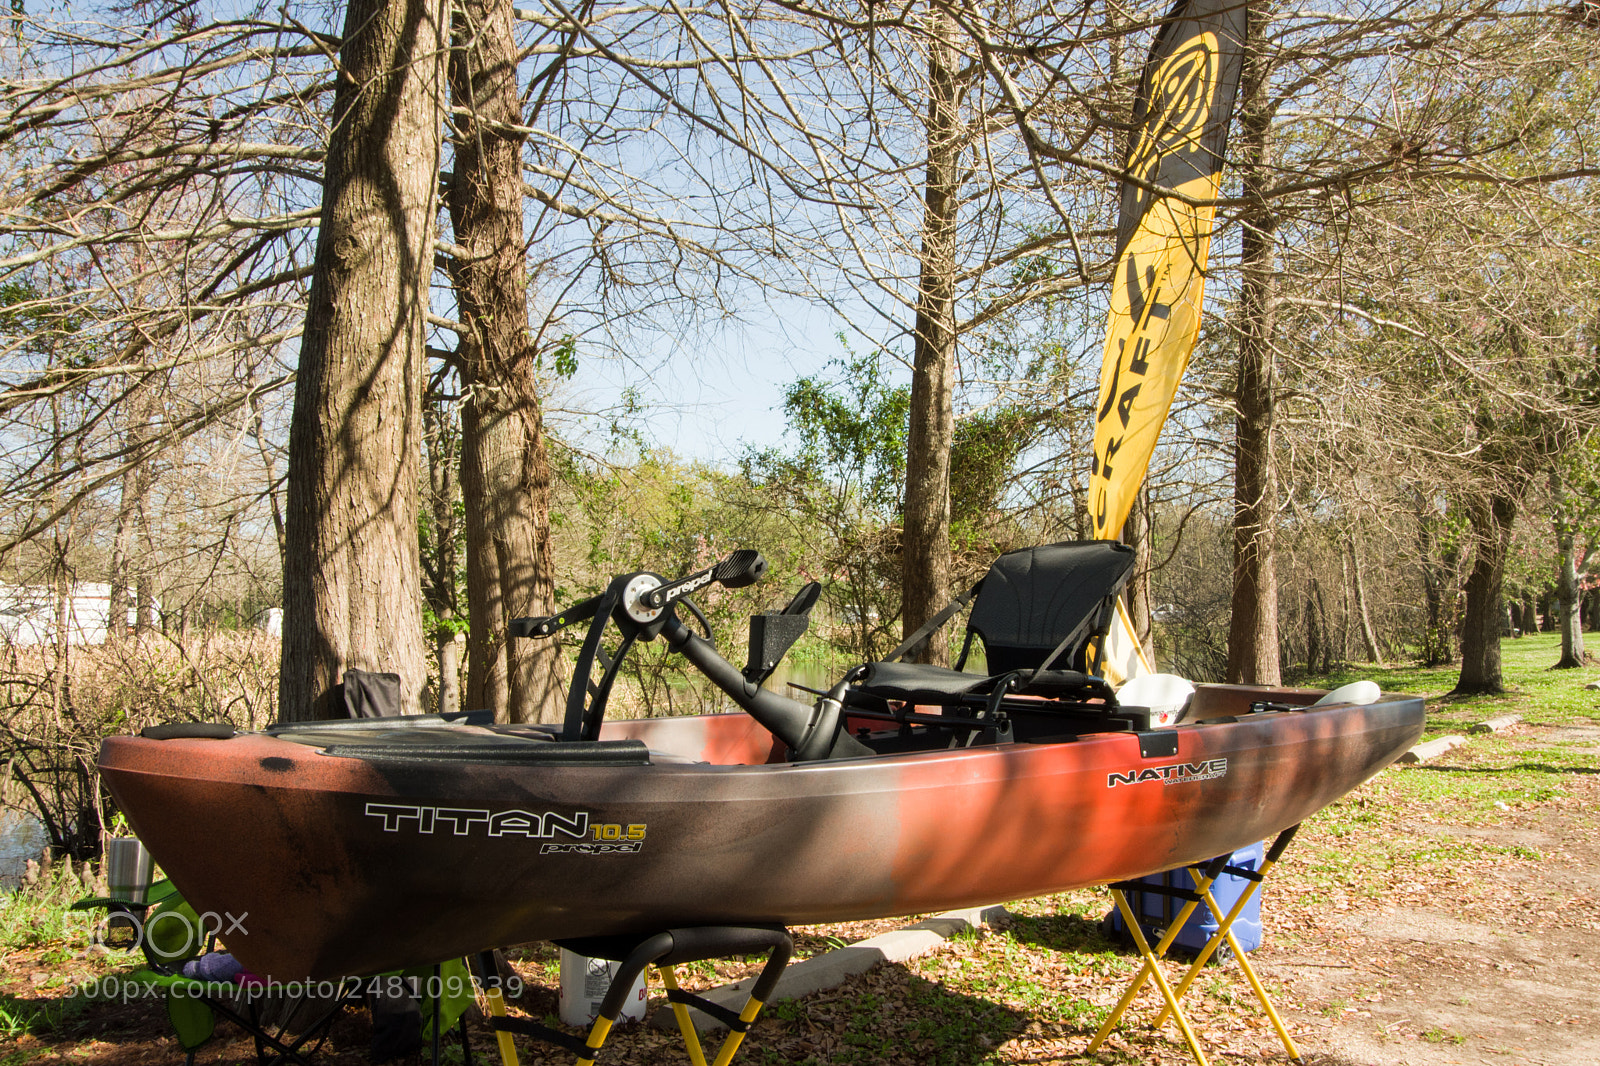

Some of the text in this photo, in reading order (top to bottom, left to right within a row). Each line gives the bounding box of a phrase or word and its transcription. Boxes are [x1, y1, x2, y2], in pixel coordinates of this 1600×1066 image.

[666, 570, 713, 602] propel
[1108, 758, 1227, 788] NATIVE
[365, 803, 647, 841] TITAN 10.5
[540, 842, 643, 855] propel
